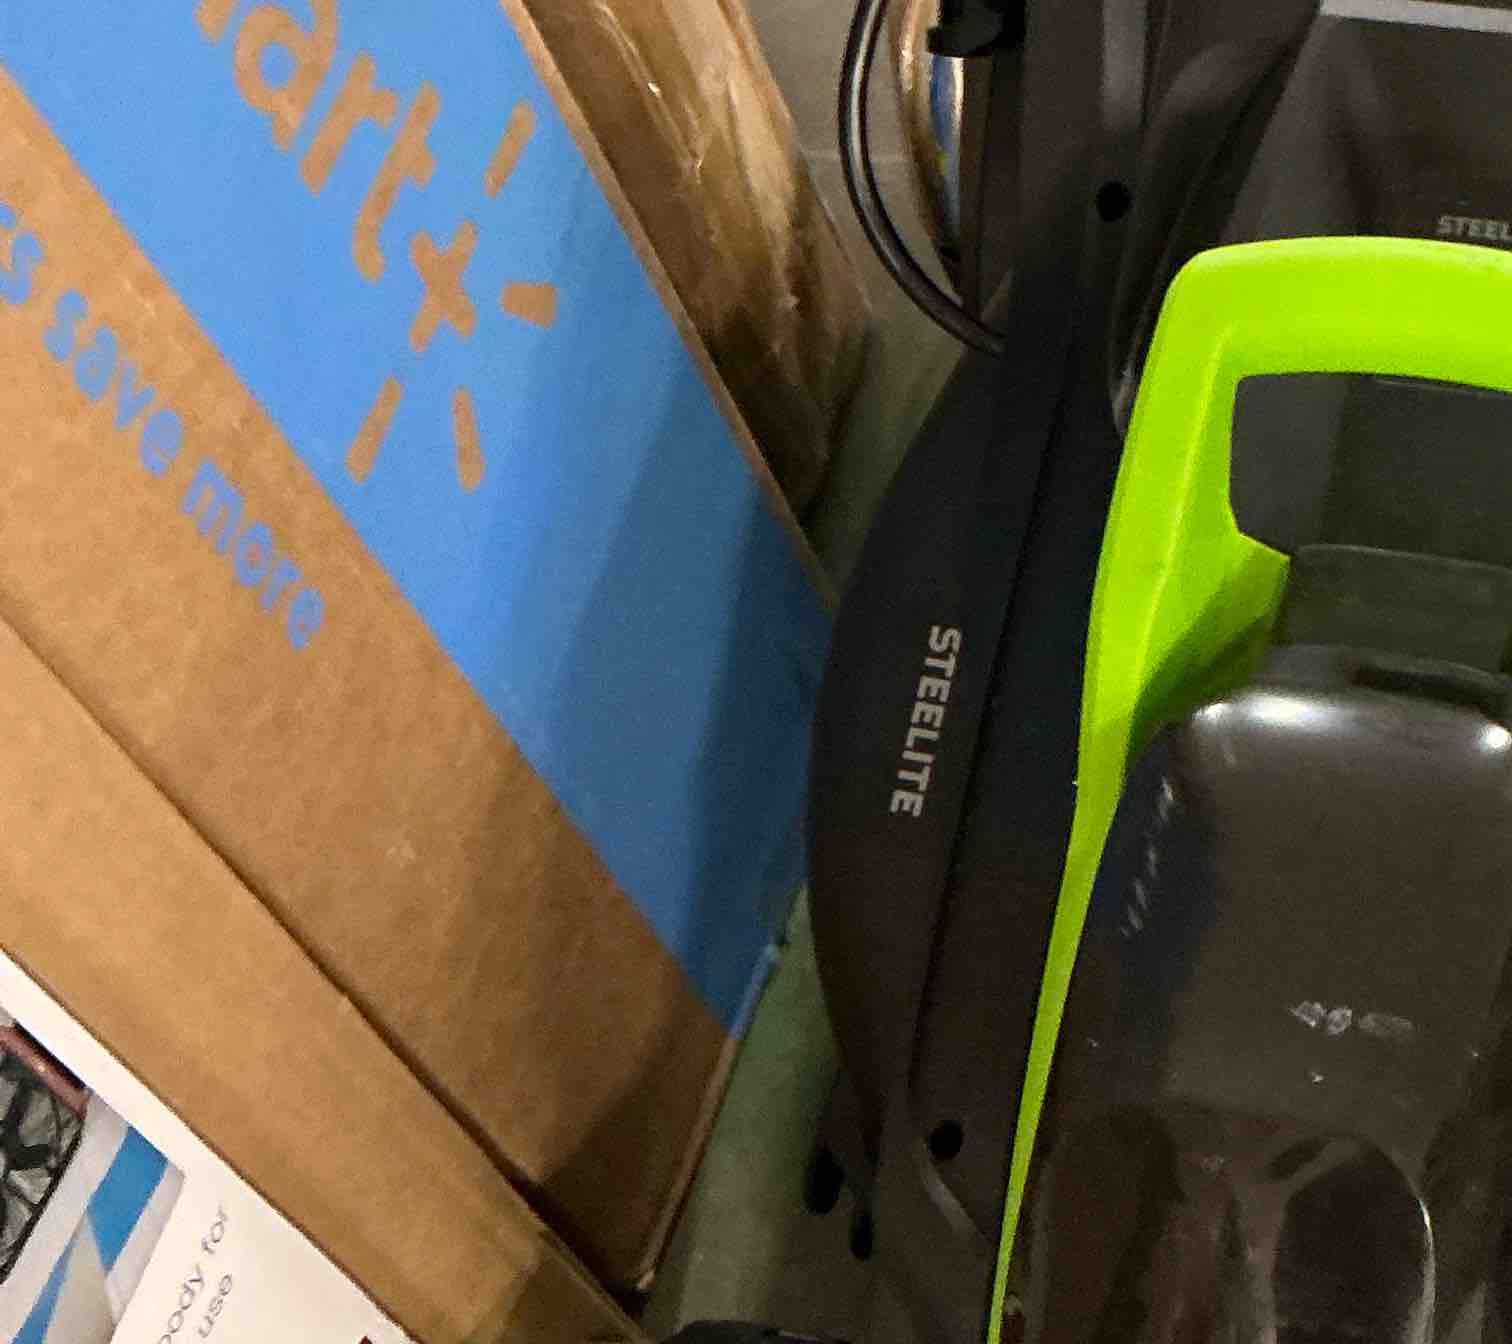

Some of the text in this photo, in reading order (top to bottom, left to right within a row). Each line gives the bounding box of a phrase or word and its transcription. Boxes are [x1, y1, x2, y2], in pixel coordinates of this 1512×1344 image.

[44, 288, 184, 477] save
[179, 457, 327, 650] more
[889, 624, 963, 817] STEELITE
[201, 1202, 228, 1255] for
[198, 1273, 233, 1338] use
